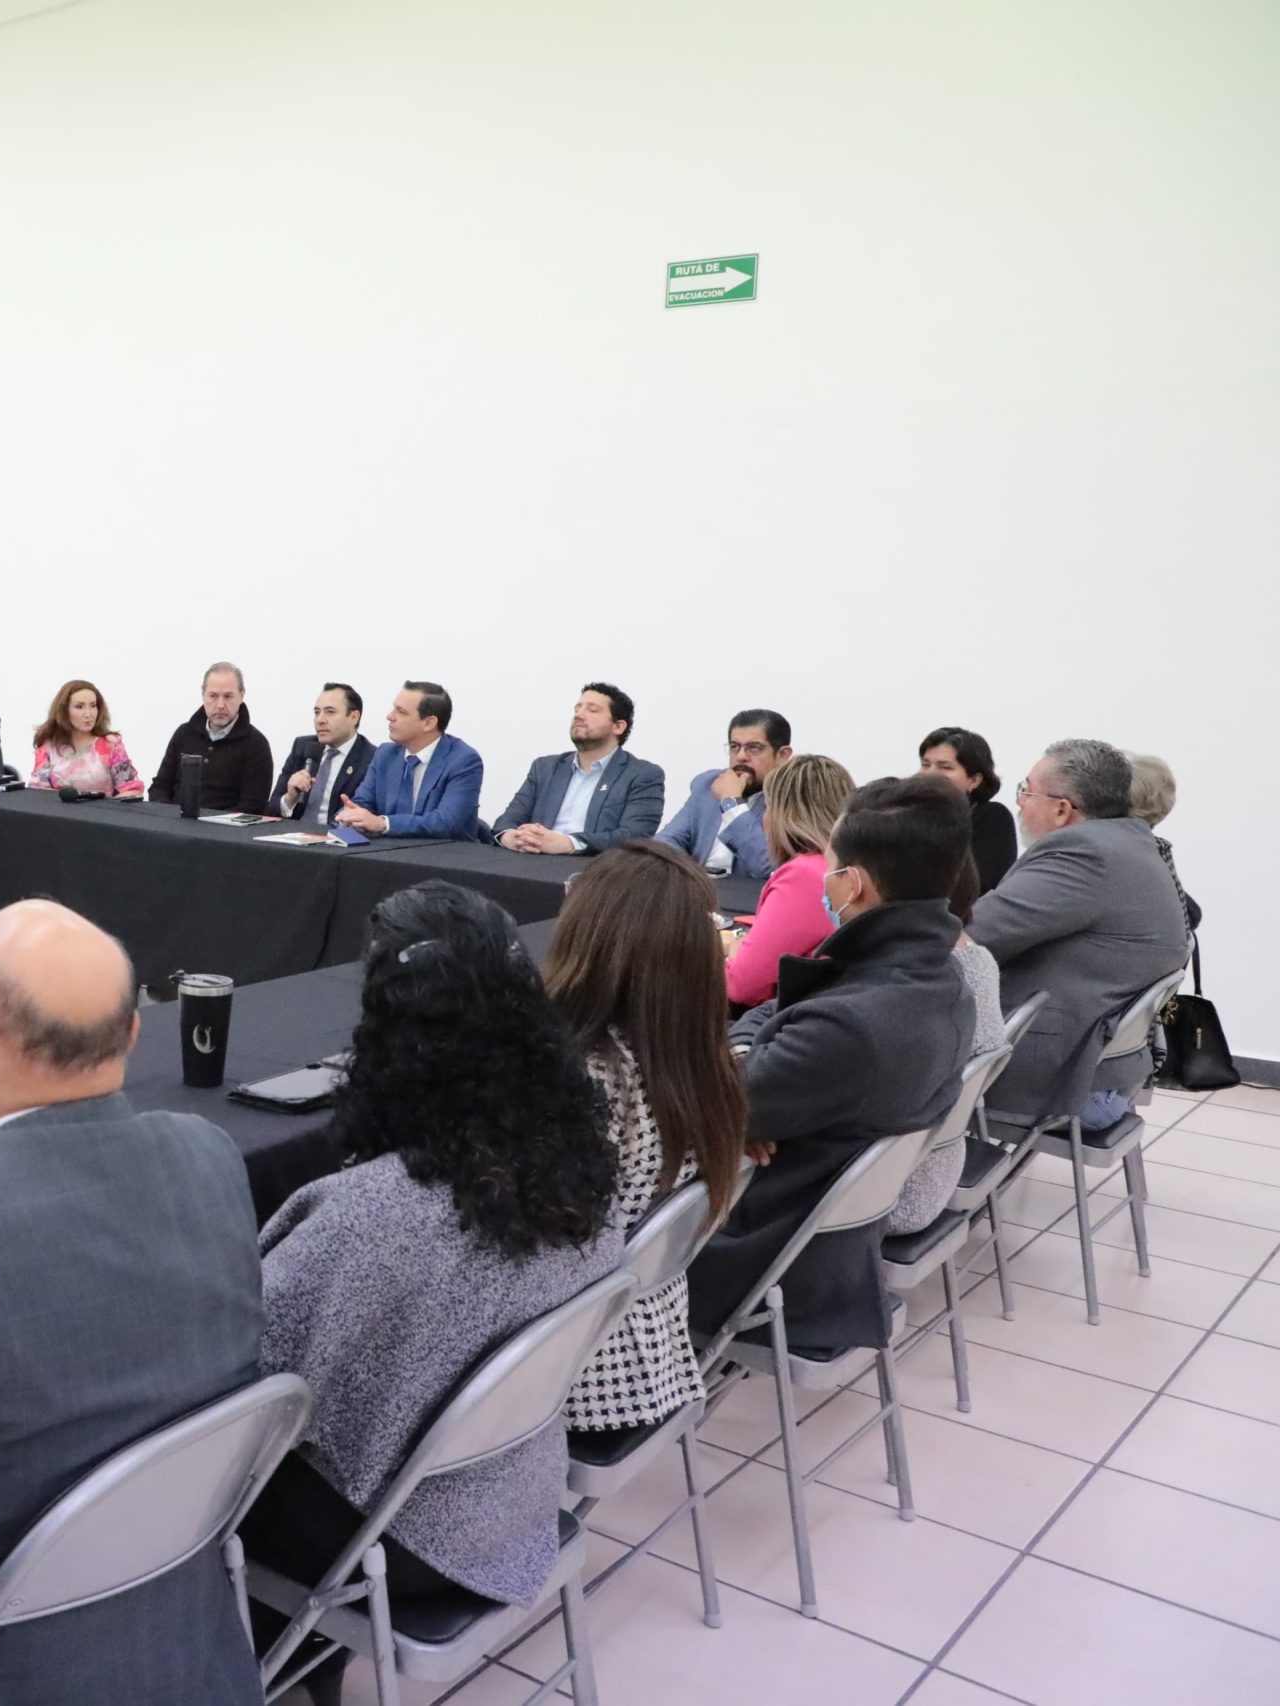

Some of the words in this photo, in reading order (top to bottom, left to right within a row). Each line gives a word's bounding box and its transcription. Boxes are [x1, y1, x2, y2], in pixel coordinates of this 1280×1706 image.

[675, 264, 703, 276] RUTA
[705, 263, 720, 272] DE
[669, 289, 724, 301] EVACUACION
